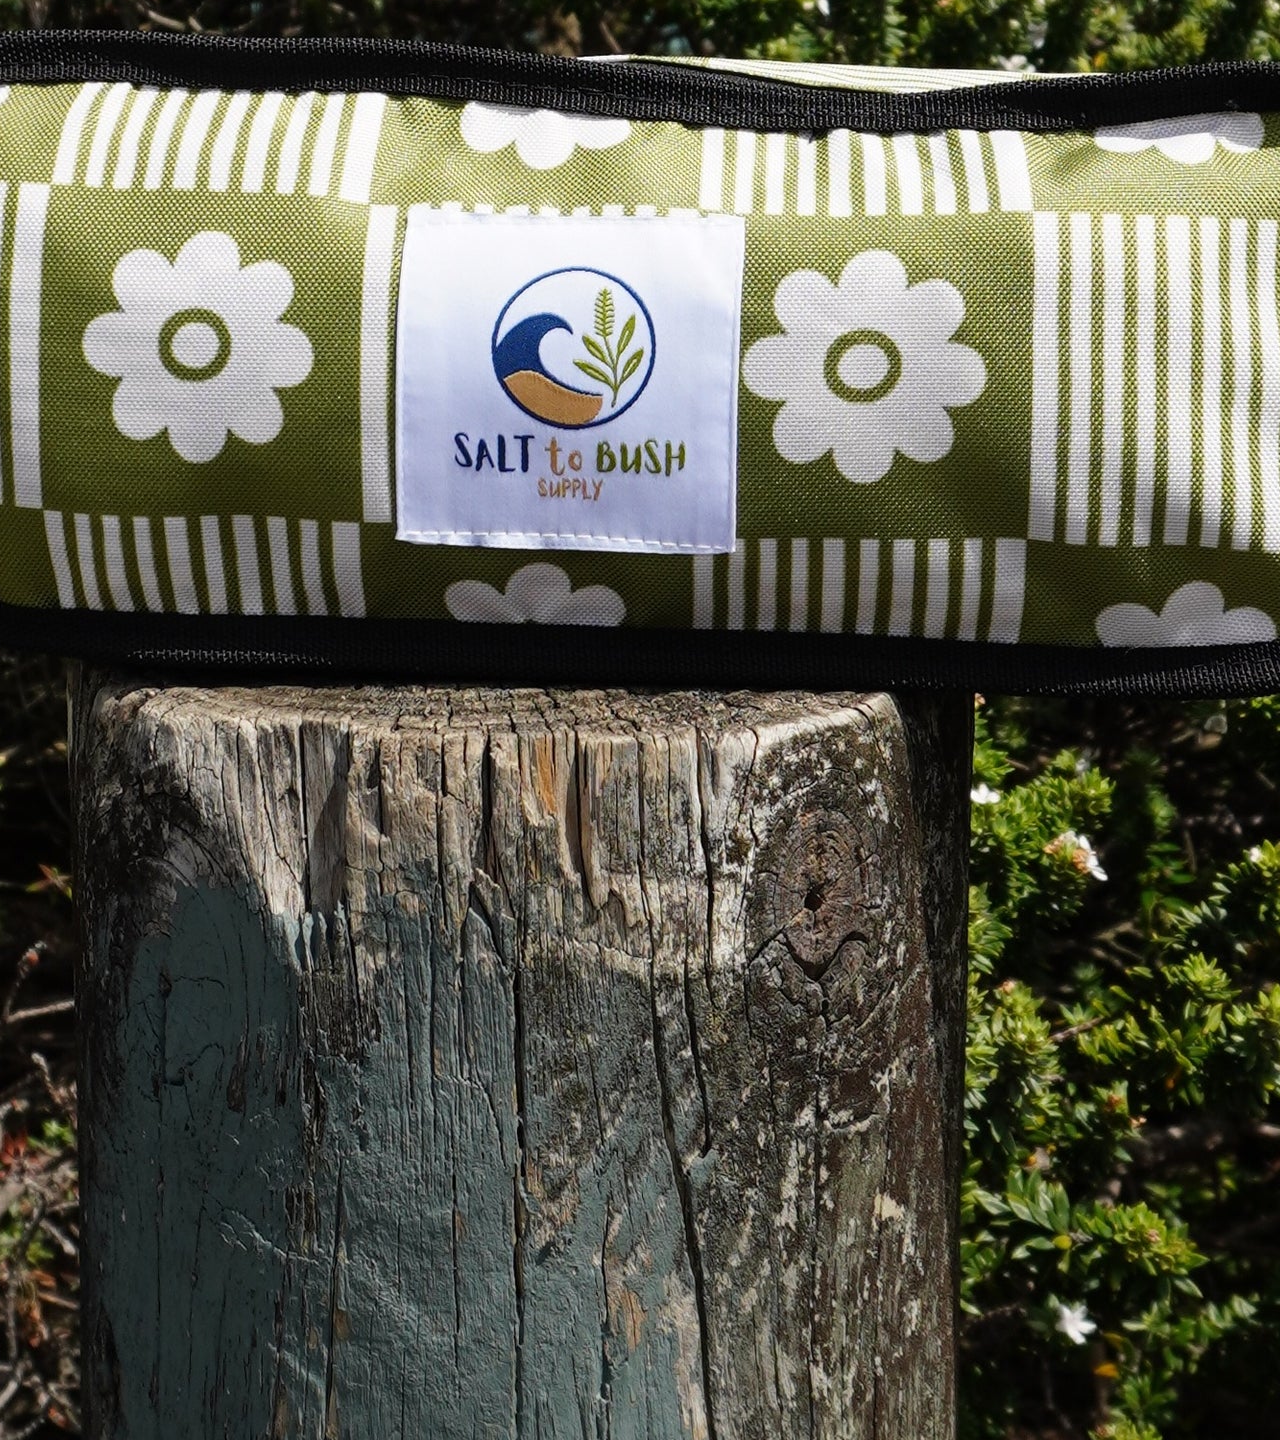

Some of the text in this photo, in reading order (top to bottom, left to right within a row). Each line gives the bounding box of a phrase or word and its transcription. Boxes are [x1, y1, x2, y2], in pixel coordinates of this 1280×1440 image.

[454, 432, 686, 476] SALT to BUSH
[538, 477, 604, 501] SUPPLY
